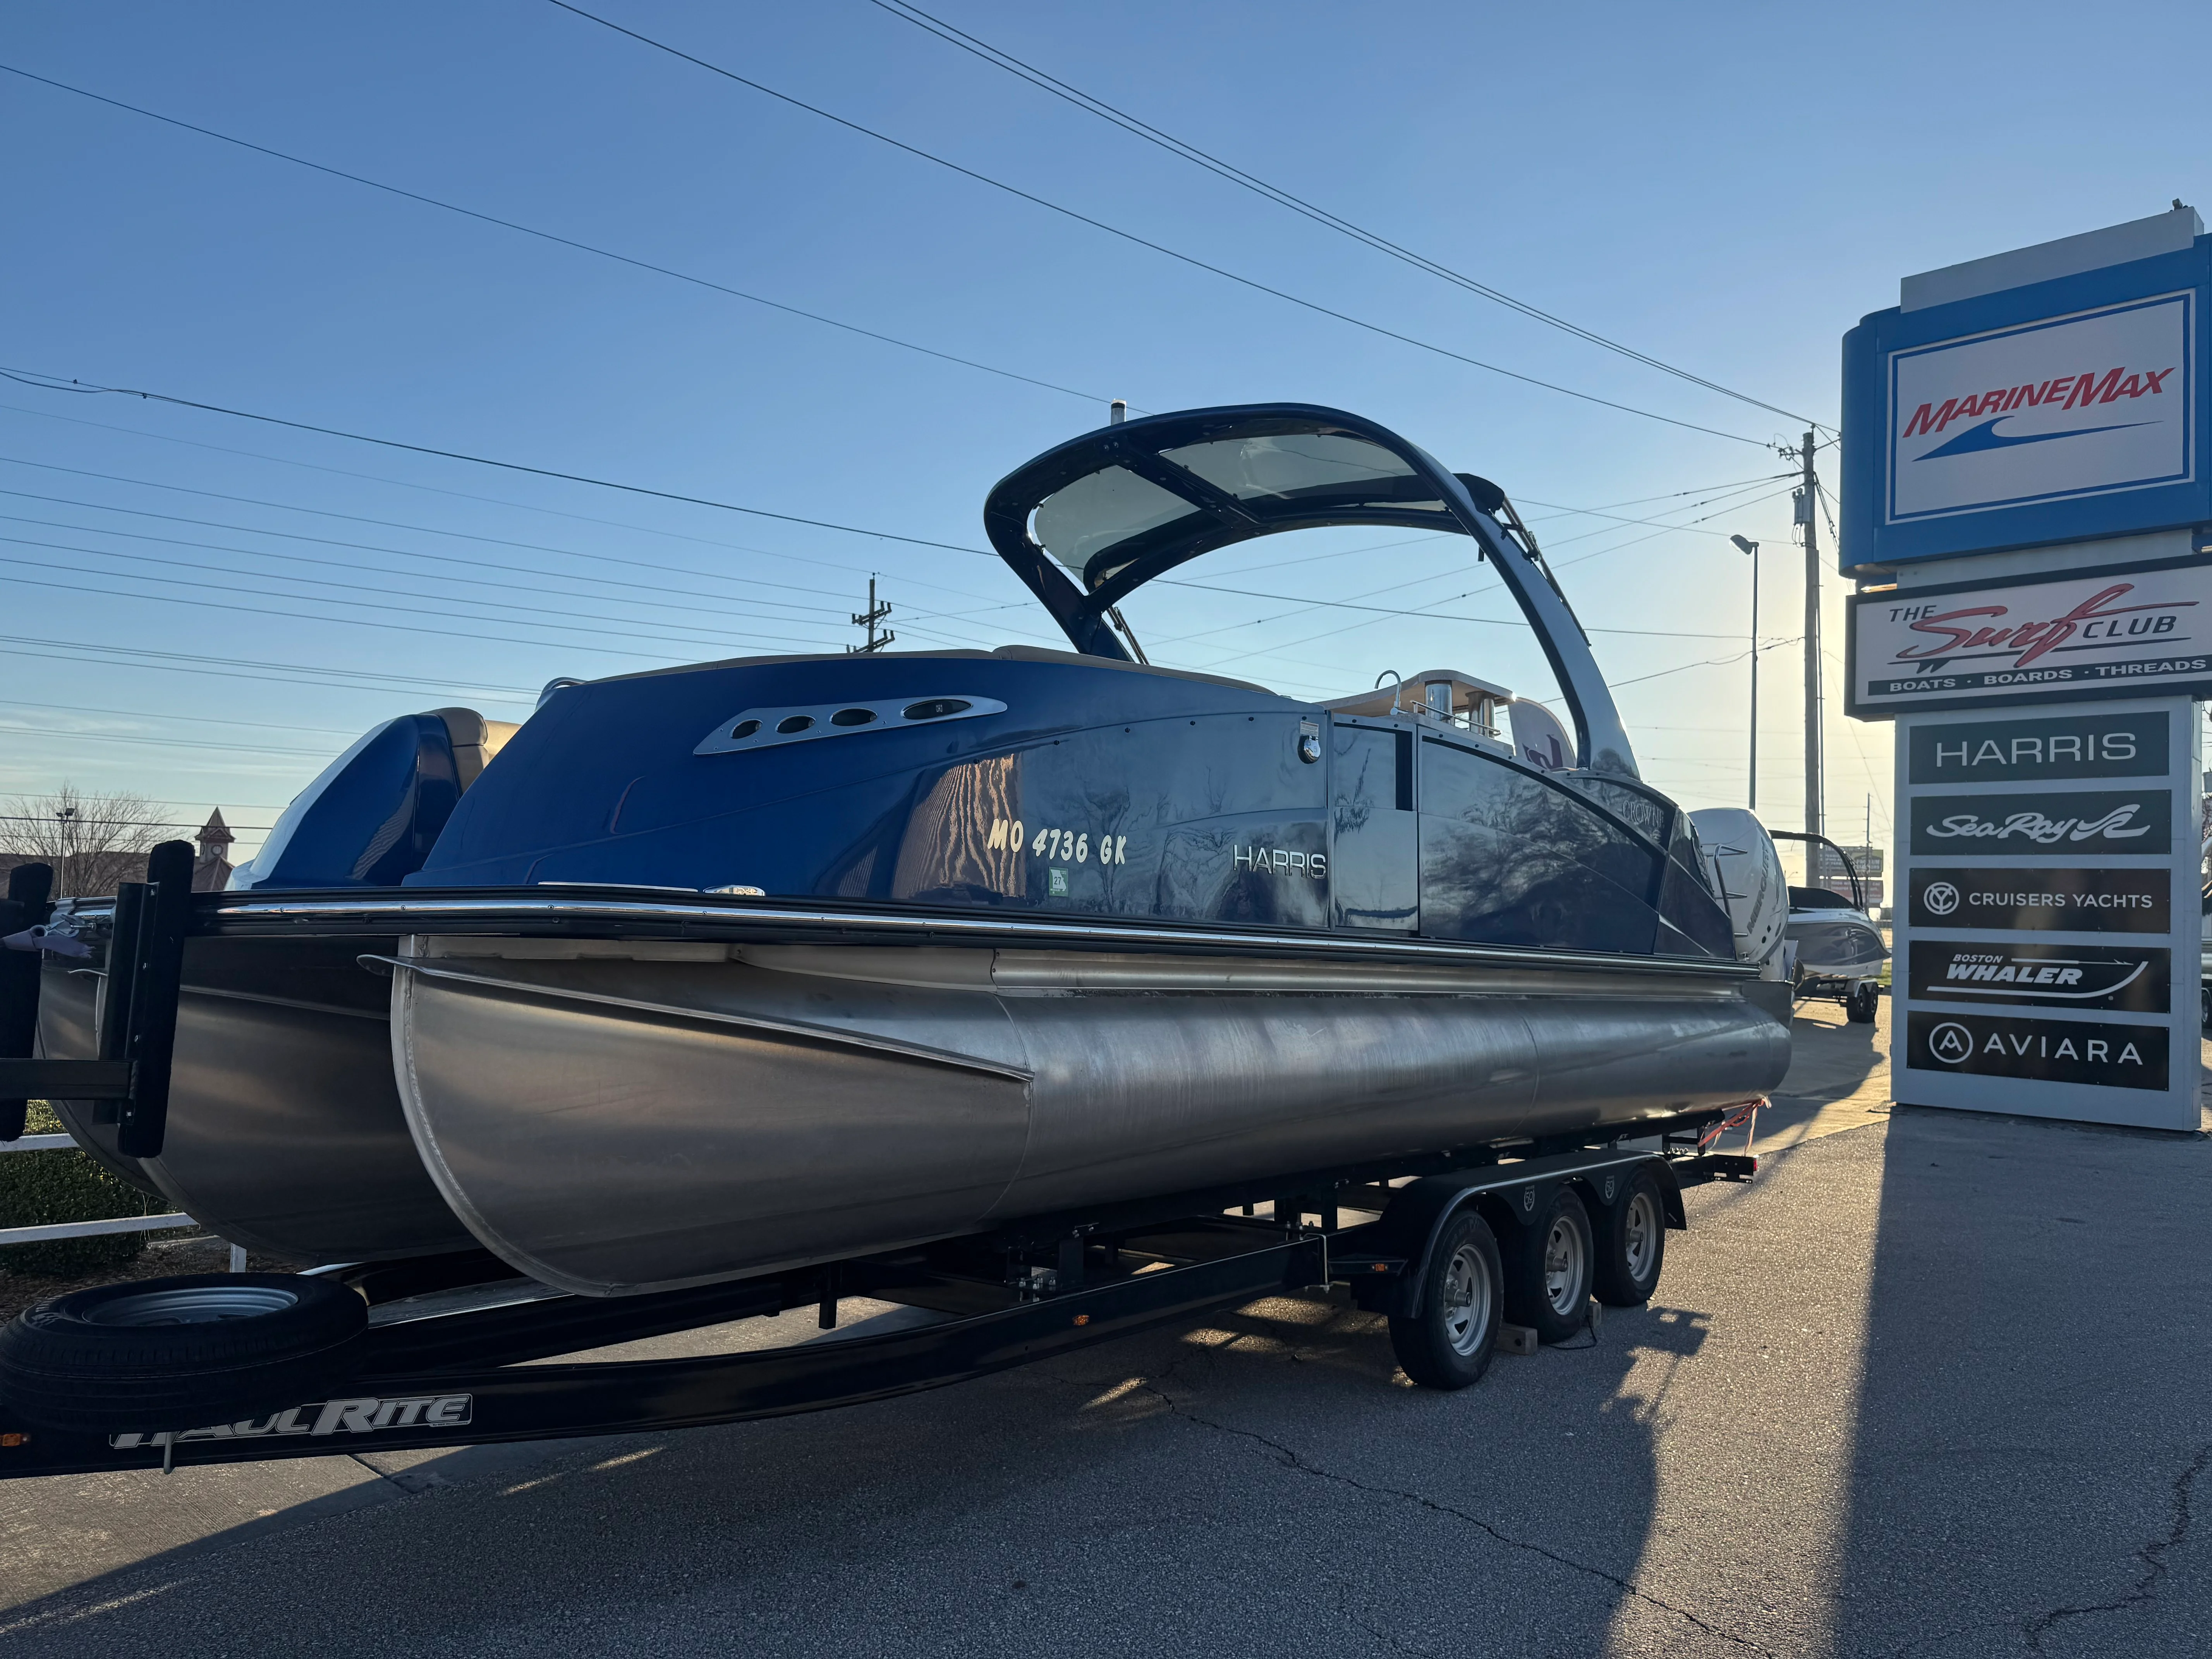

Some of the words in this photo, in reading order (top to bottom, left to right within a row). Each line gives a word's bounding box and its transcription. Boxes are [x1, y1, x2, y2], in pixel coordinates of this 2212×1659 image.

[1889, 605, 1937, 623] THE
[1896, 583, 2200, 668] Surf
[2083, 616, 2177, 639] CLUB
[1890, 678, 1956, 692] BOATS
[1984, 669, 2073, 685] BOARDS
[2095, 659, 2207, 676] THREADS
[1936, 732, 2136, 767] HARRIS
[988, 818, 1024, 853] MO
[1032, 828, 1089, 864] 4736
[1100, 835, 1127, 865] GK
[1926, 815, 2004, 838] Sea
[1997, 812, 2078, 843] Ray
[1233, 844, 1326, 879] HARRIS
[1054, 876, 1061, 885] 27
[1969, 892, 2066, 907] CRUISERS
[2073, 894, 2153, 908] YACHTS
[1946, 963, 2083, 986] WHALER
[1953, 954, 2003, 964] BOSTON
[1983, 1032, 2144, 1066] AVIARA
